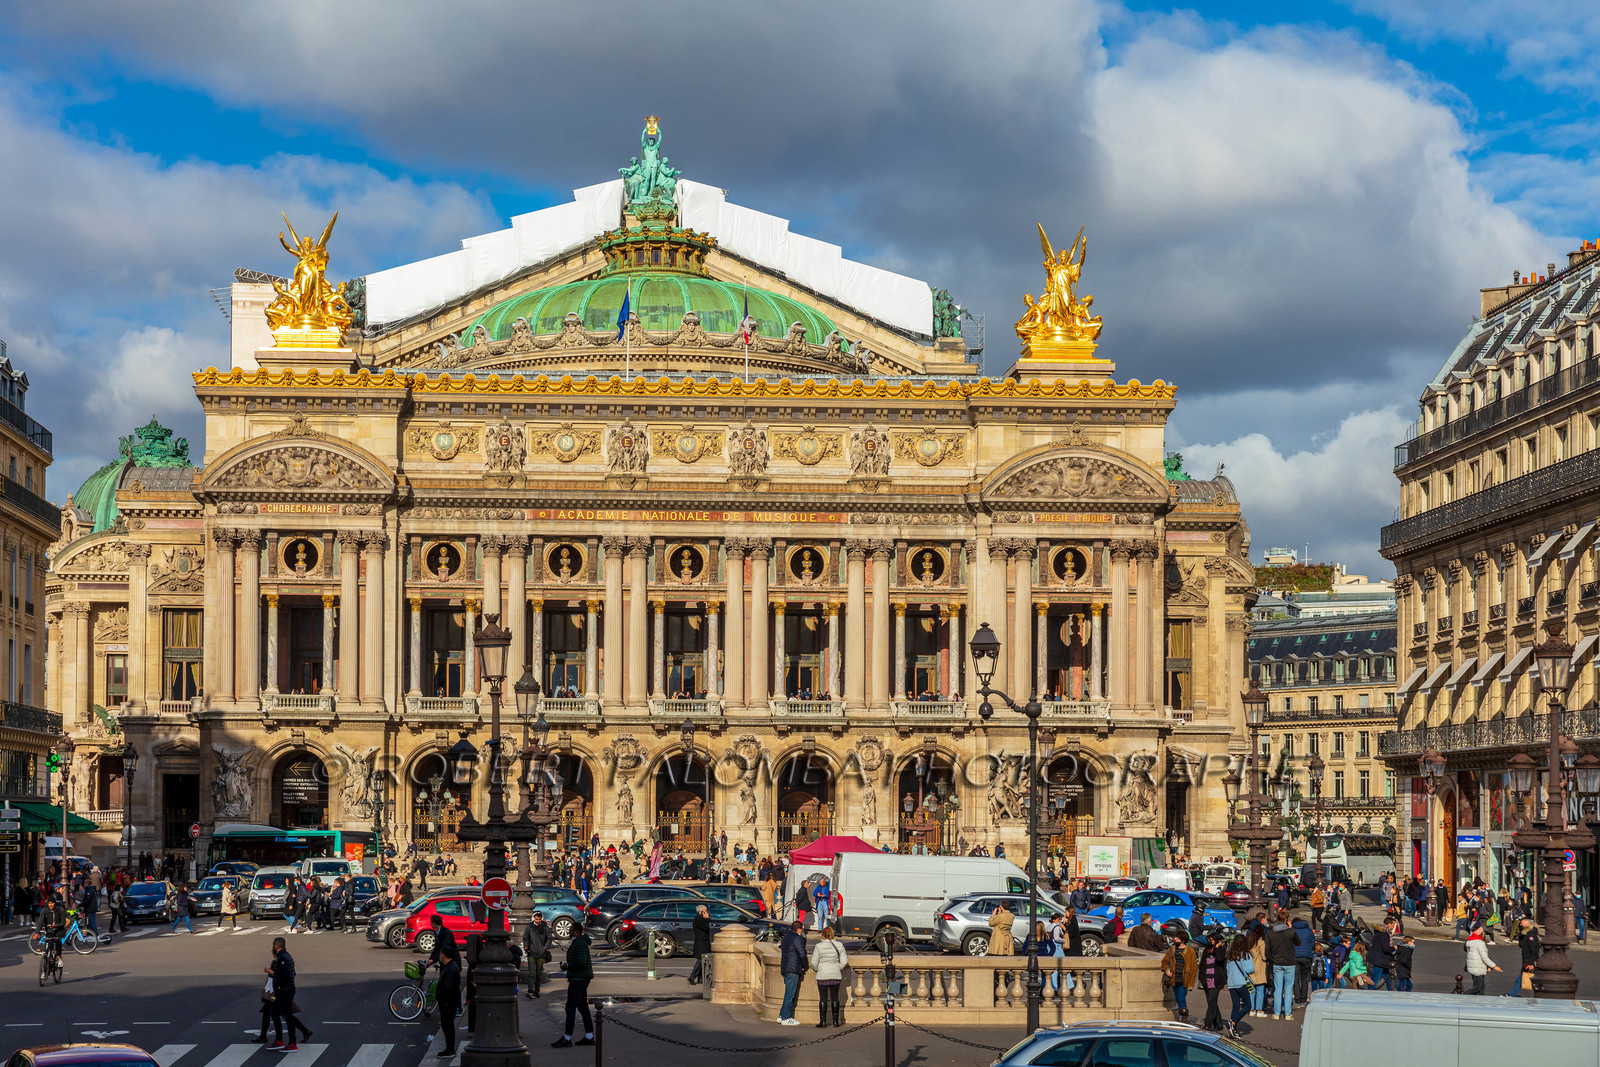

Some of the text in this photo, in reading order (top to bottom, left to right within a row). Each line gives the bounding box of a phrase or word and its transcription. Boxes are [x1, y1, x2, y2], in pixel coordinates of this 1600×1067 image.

[440, 437, 448, 446] N
[502, 437, 508, 446] E
[562, 438, 570, 447] N
[624, 438, 630, 447] E
[684, 440, 692, 449] N
[746, 440, 751, 449] E
[804, 441, 812, 450] N
[867, 442, 873, 450] E
[925, 442, 933, 451] N
[267, 504, 332, 513] CHOREGRAPHIE
[558, 510, 817, 523] ACADEMIE NATIONALE DE MUSIQUE
[1040, 514, 1107, 523] POESIE LYRIQUE
